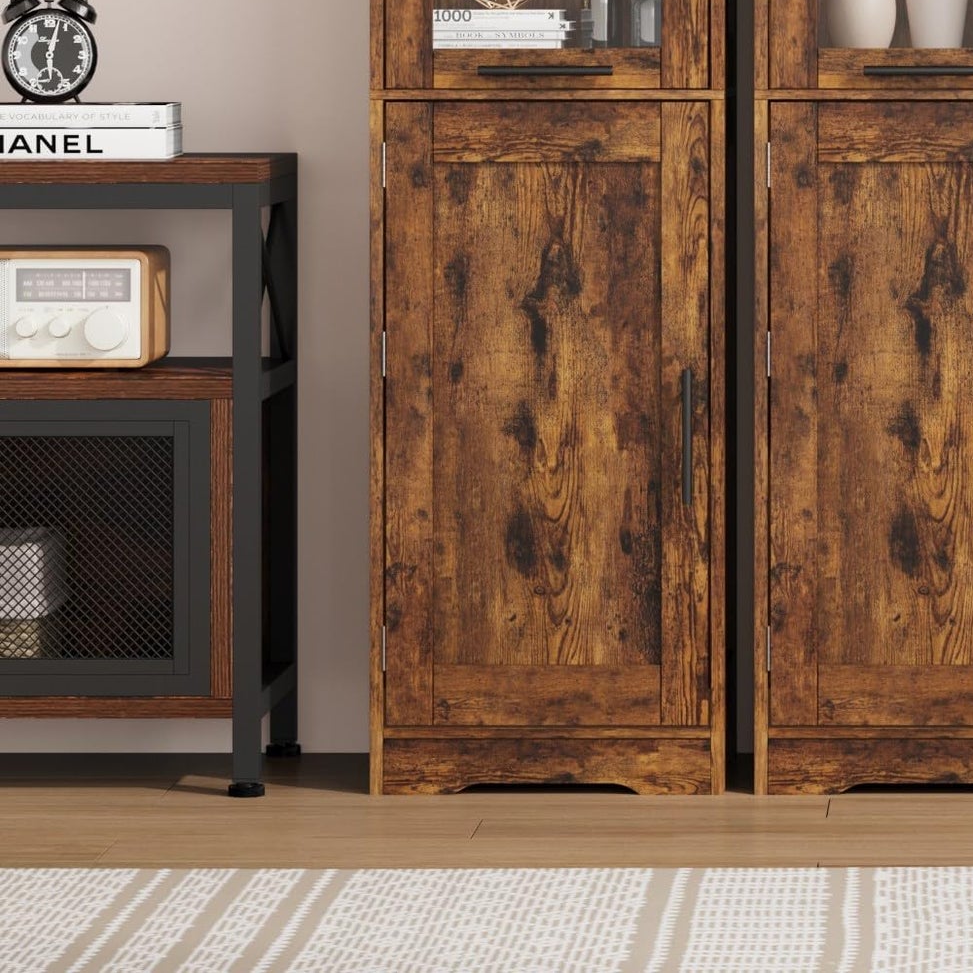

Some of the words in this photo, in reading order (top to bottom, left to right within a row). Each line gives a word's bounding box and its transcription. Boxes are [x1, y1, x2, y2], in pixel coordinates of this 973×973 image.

[434, 10, 472, 22] 1000
[9, 113, 79, 121] VOCABULARY
[81, 113, 95, 121] OF
[99, 113, 132, 121] STYLE
[0, 134, 104, 154] ANEL
